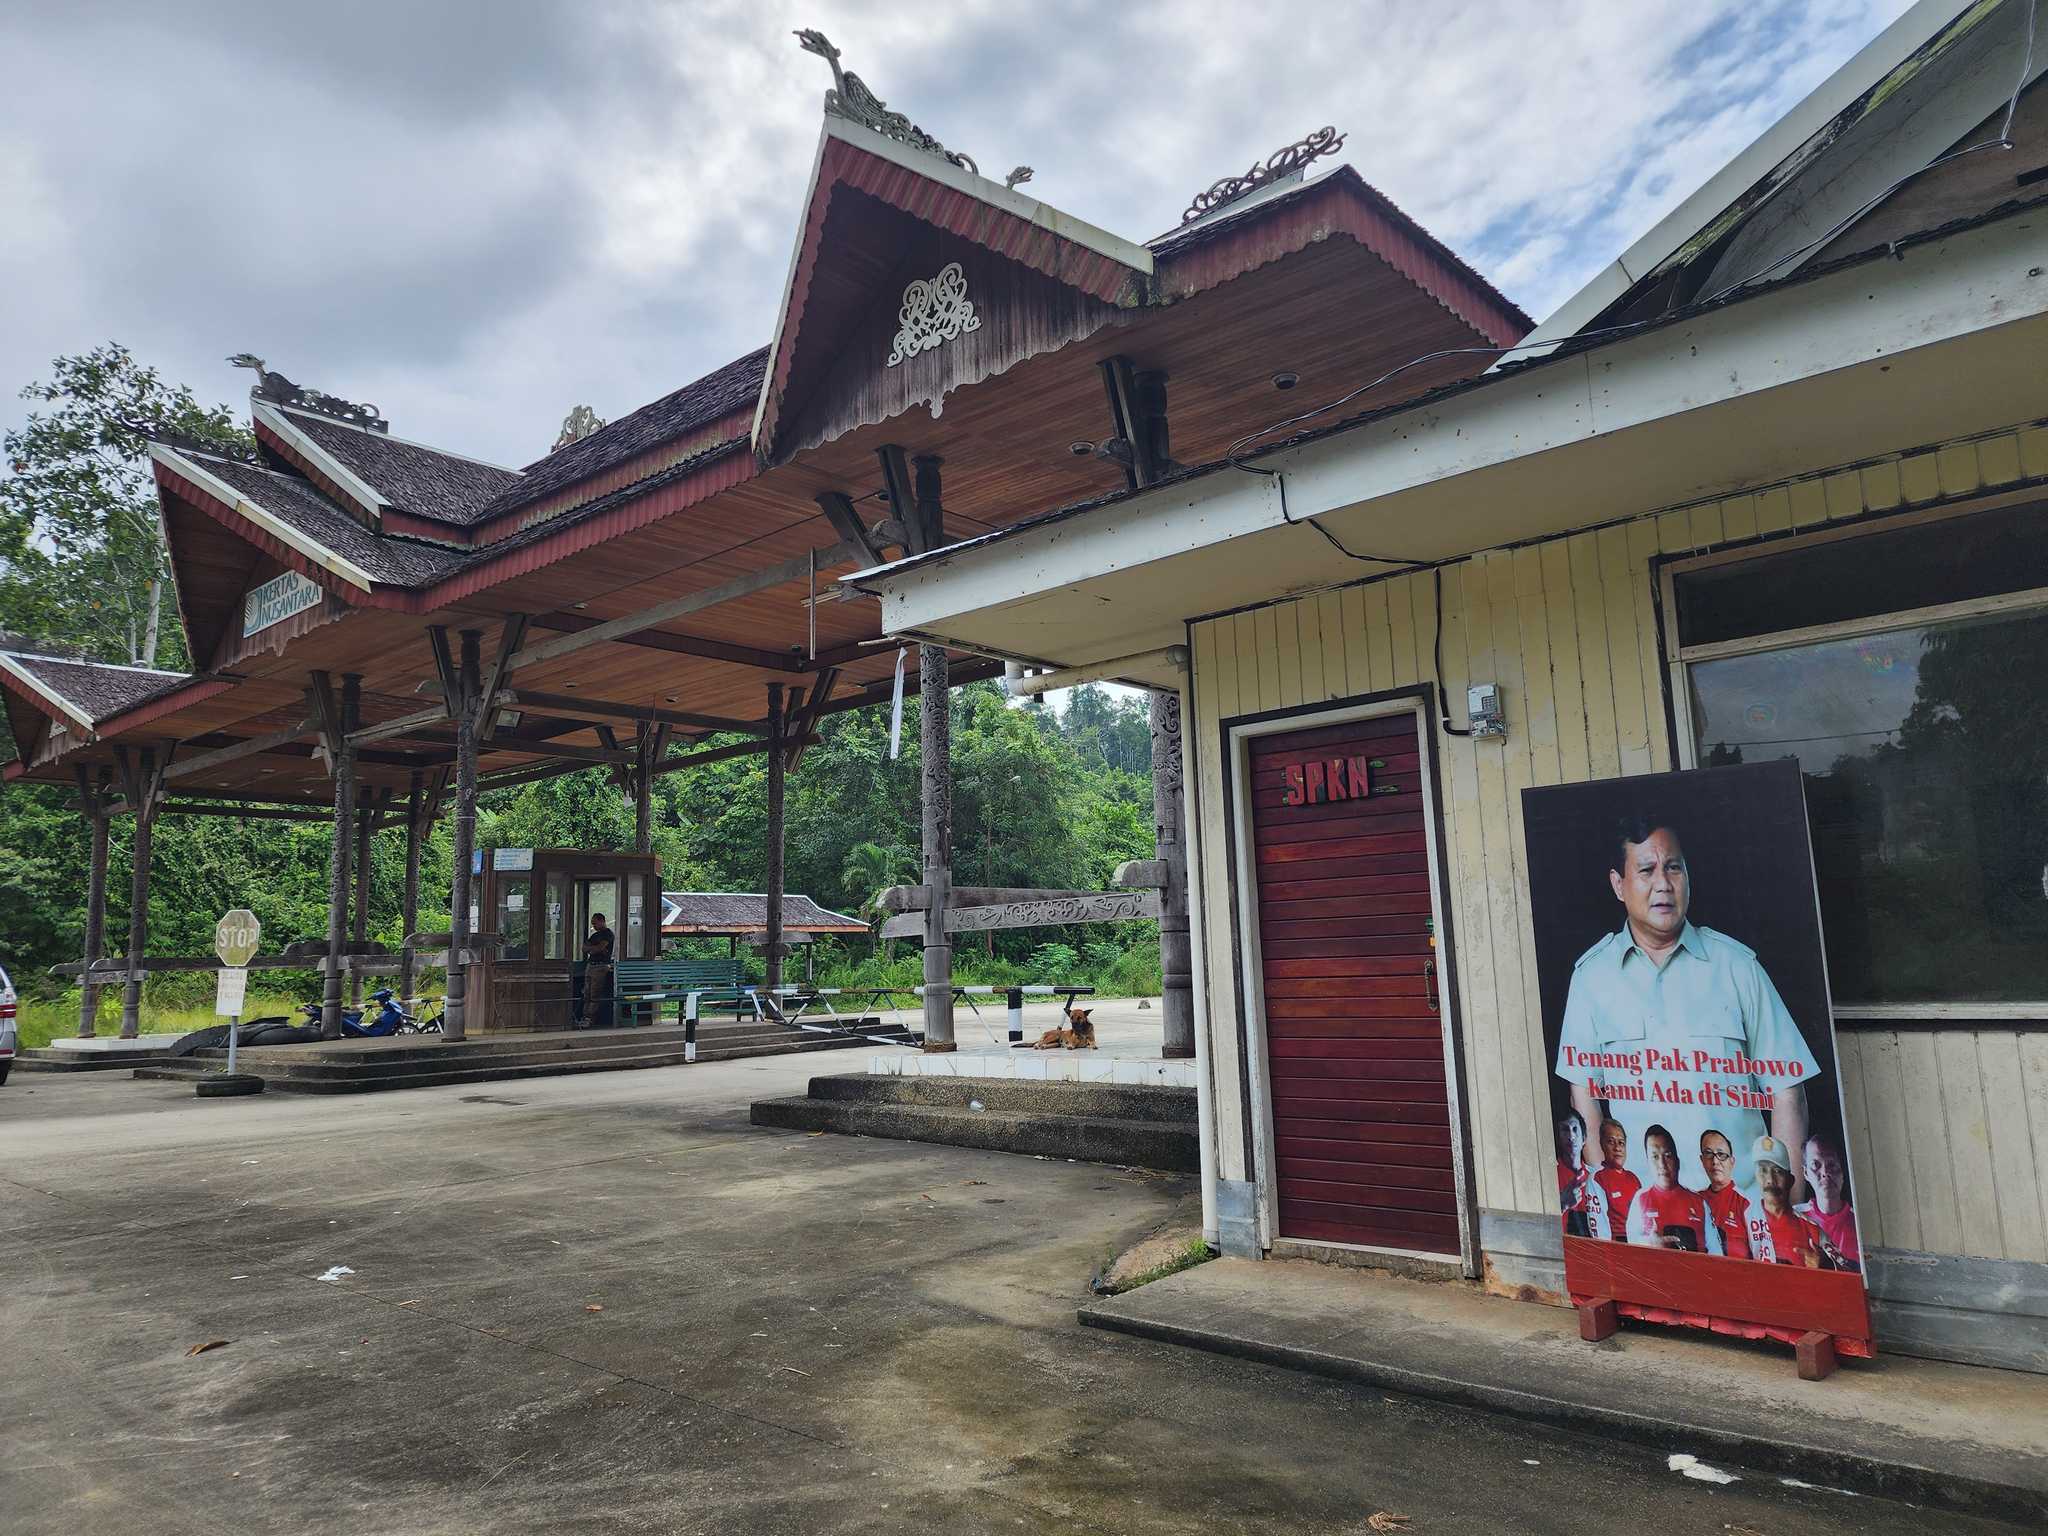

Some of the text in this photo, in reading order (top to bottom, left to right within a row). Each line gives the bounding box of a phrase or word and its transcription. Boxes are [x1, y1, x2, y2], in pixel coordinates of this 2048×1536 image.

[263, 573, 299, 603] KERTAS
[261, 585, 320, 626] NUSANTARA
[1285, 756, 1369, 806] SPKN
[218, 927, 257, 948] STOP
[1562, 1045, 1804, 1078] Tenang Pak Prabowo
[1587, 1077, 1775, 1110] Kami Ada di Sini
